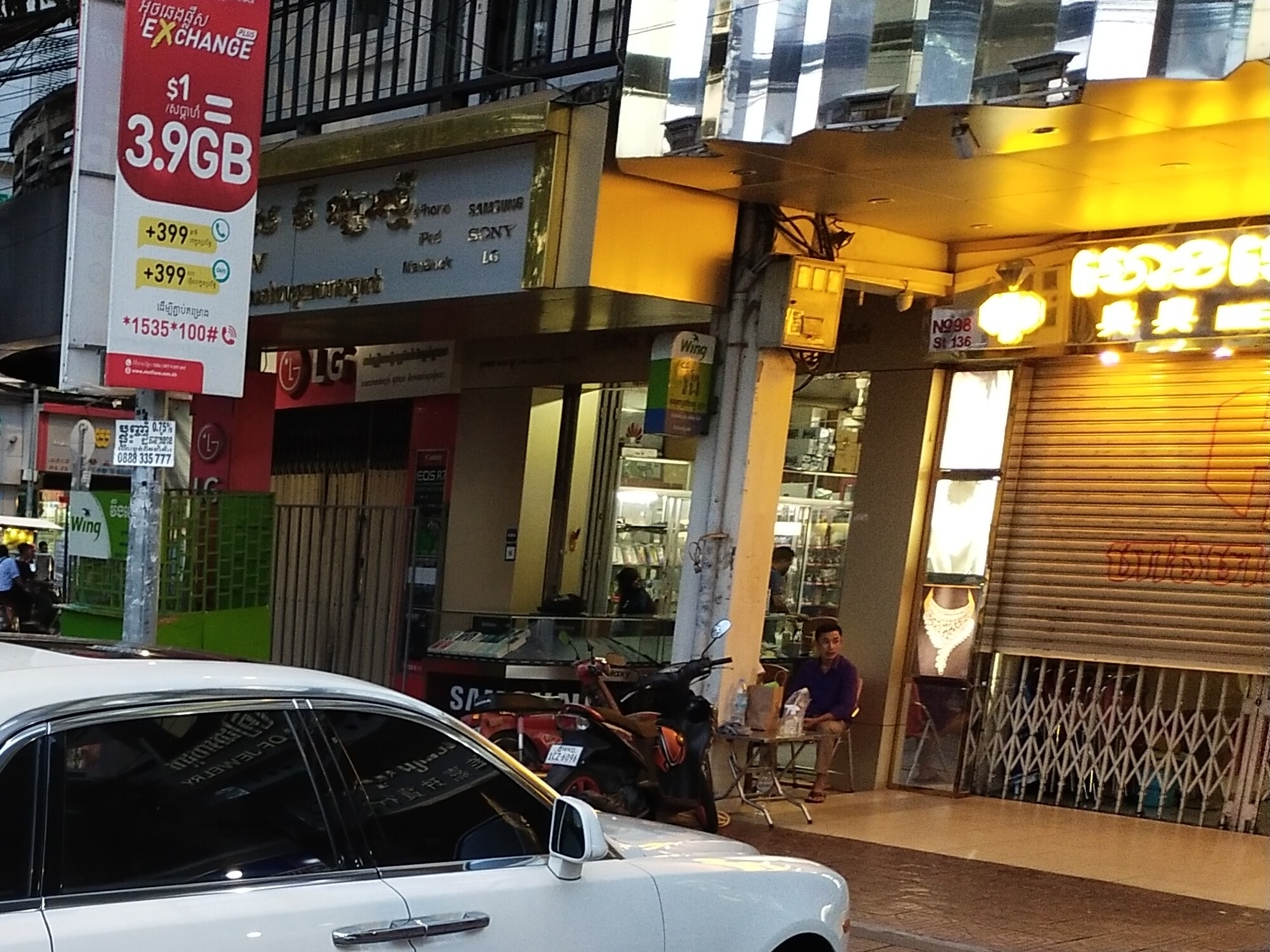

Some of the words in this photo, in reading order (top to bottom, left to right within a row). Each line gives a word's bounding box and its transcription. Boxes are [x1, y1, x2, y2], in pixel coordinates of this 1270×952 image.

[142, 17, 254, 60] EXCHANGE
[166, 73, 190, 101] $1
[125, 114, 253, 185] 3.9GB
[468, 196, 524, 216] SAMSUNG
[145, 221, 189, 245] +399
[467, 224, 517, 242] SONY
[481, 249, 500, 265] LG
[143, 263, 186, 286] +399
[680, 338, 708, 361] Wing
[933, 336, 947, 349] St
[950, 335, 972, 348] 136
[309, 347, 345, 383] LG
[139, 452, 153, 464] 335
[155, 453, 171, 465] 777
[71, 515, 102, 542] Wing
